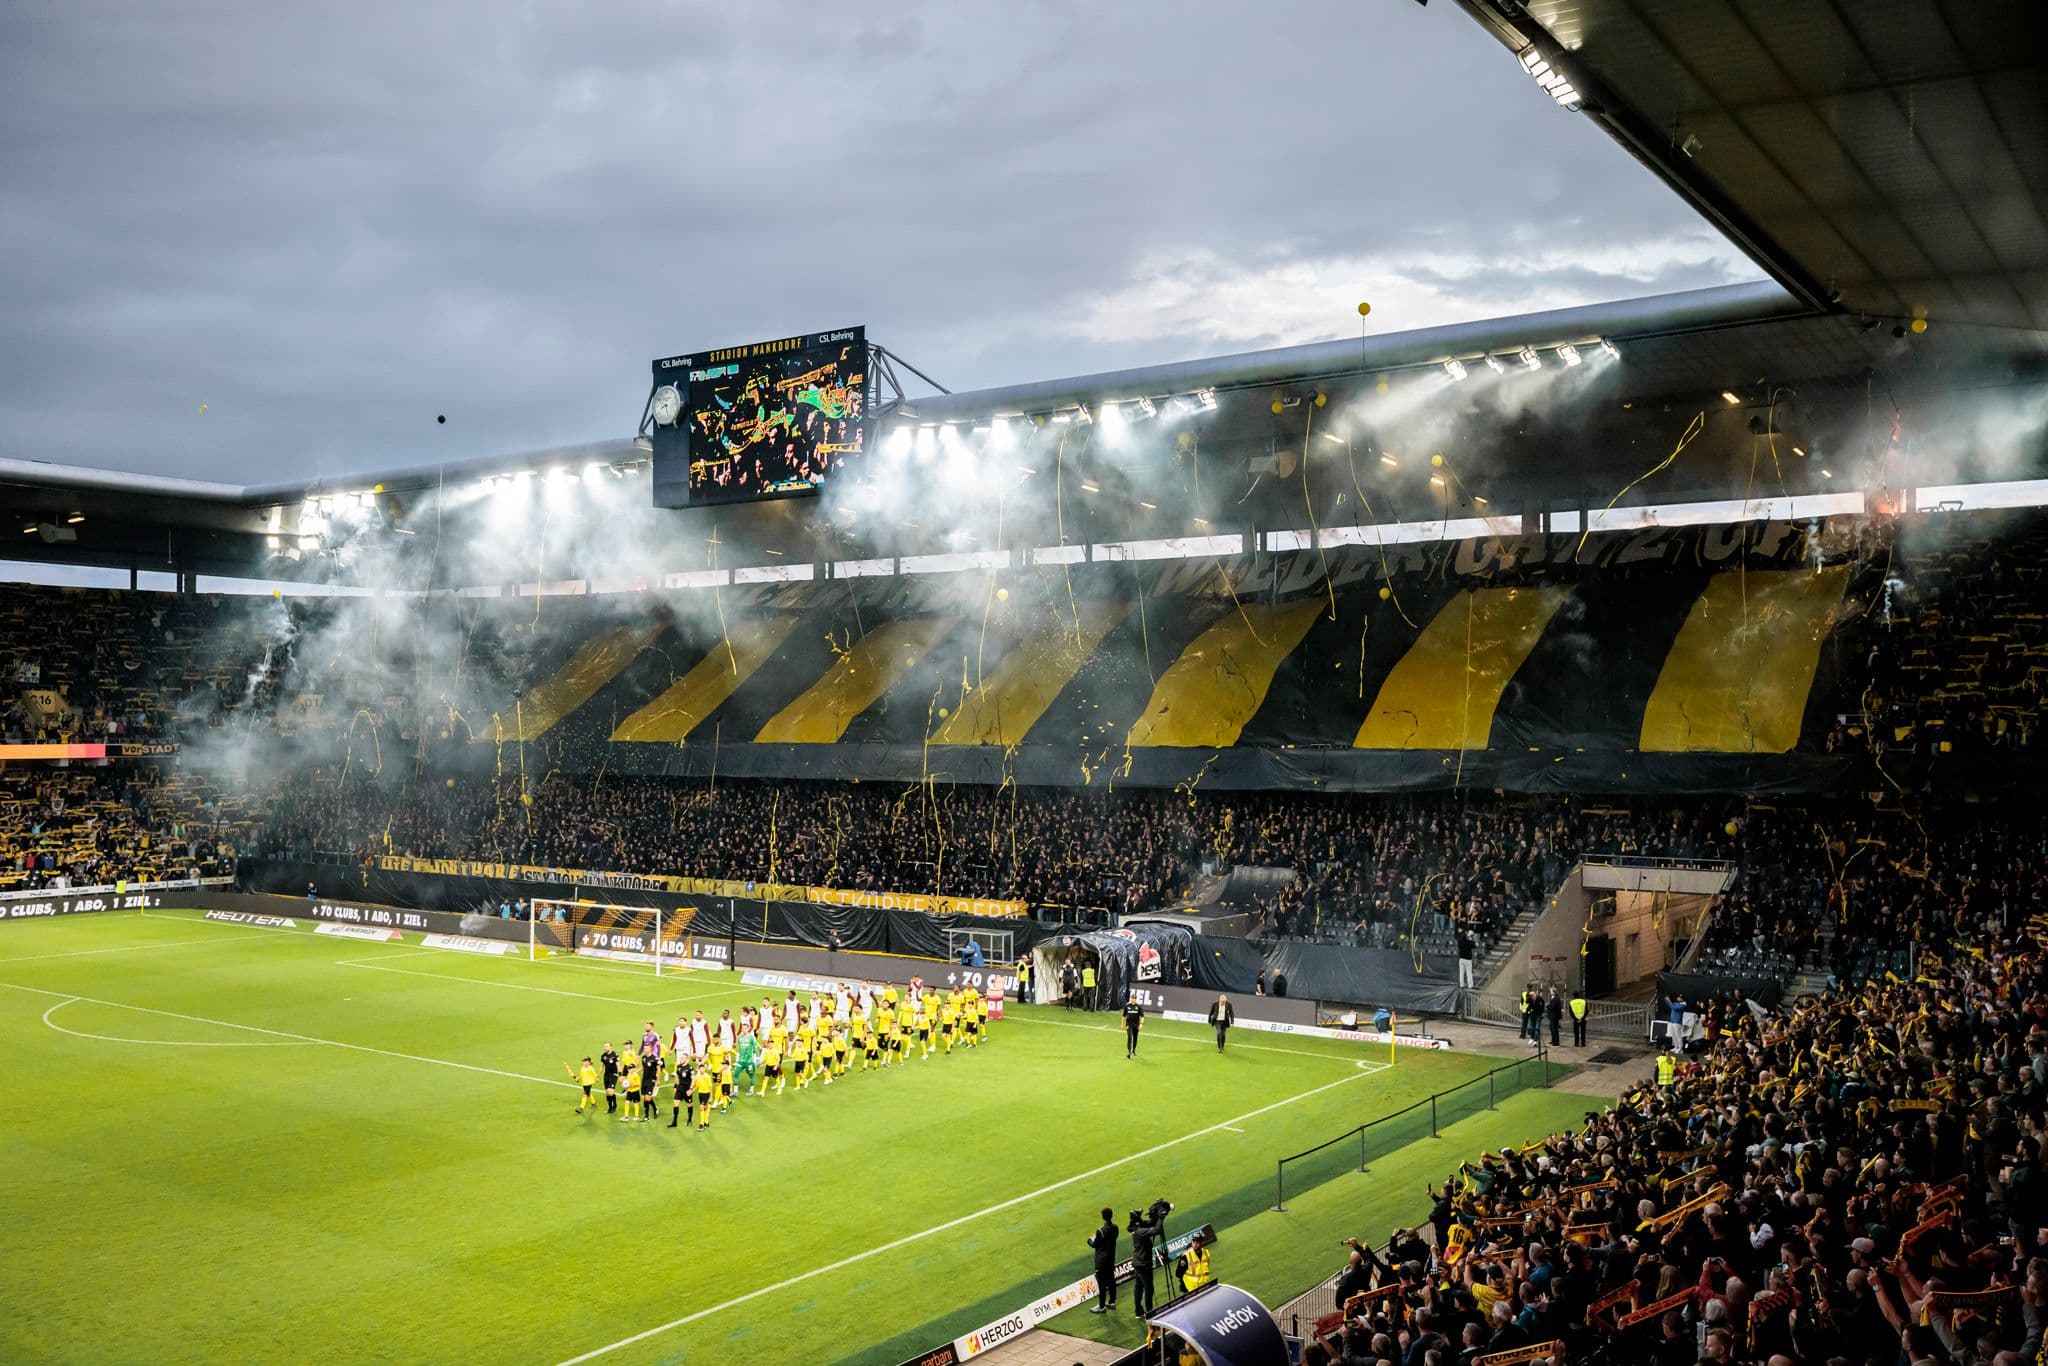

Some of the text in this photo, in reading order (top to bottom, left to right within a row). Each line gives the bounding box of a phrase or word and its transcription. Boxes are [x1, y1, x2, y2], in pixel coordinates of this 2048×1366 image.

[820, 331, 854, 343] CSL Behring
[710, 346, 748, 362] STADION
[662, 358, 692, 369] CSL Behring
[12, 903, 56, 917] CLUBS,
[63, 902, 69, 912] 1
[74, 900, 106, 912] ABO,
[113, 898, 119, 908] 1
[124, 896, 151, 908] ZIEL
[320, 906, 332, 916] 70
[334, 907, 361, 922] CLUBS,
[364, 910, 368, 920] 1
[371, 910, 392, 925] ABO,
[396, 913, 400, 924] 1
[403, 913, 421, 926] ZIEL
[592, 934, 607, 947] 70
[611, 935, 645, 952] CLUBS,
[660, 940, 688, 958] ABO,
[693, 943, 699, 956] 1
[704, 944, 728, 959] ZIEL
[962, 972, 982, 987] 70
[1336, 1031, 1379, 1042] ALIGRO
[1453, 1228, 1464, 1241] 16
[1034, 1302, 1050, 1317] BYM
[1210, 1305, 1259, 1336] wefox
[980, 1316, 1024, 1347] HERZOG
